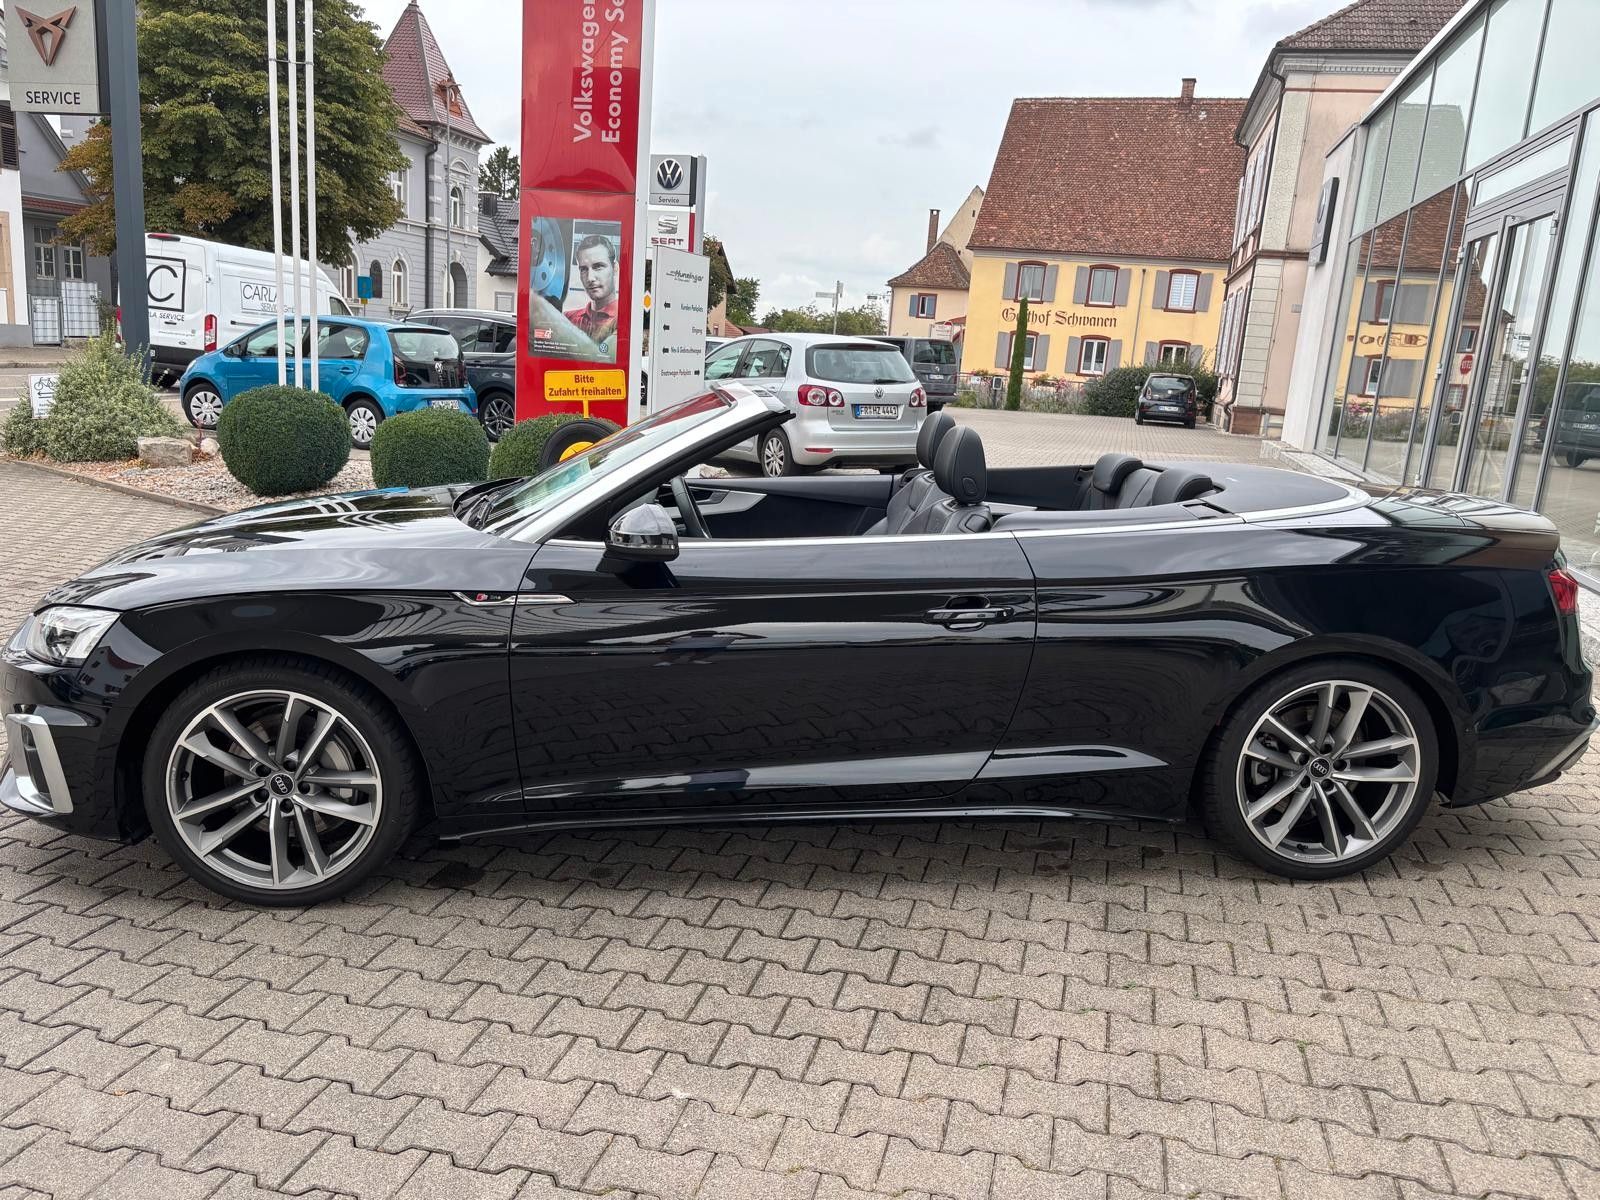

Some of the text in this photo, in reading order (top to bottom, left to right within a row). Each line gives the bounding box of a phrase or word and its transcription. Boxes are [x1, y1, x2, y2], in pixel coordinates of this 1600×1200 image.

[573, 0, 599, 143] Volkswage
[602, 31, 629, 143] Economy
[26, 91, 81, 105] SERVICE
[651, 237, 684, 245] SEAT
[159, 312, 185, 321] SERVICE
[1054, 311, 1118, 328] Schwanen
[574, 374, 594, 384] Bitte
[548, 387, 622, 397] Zufahrt freihalten
